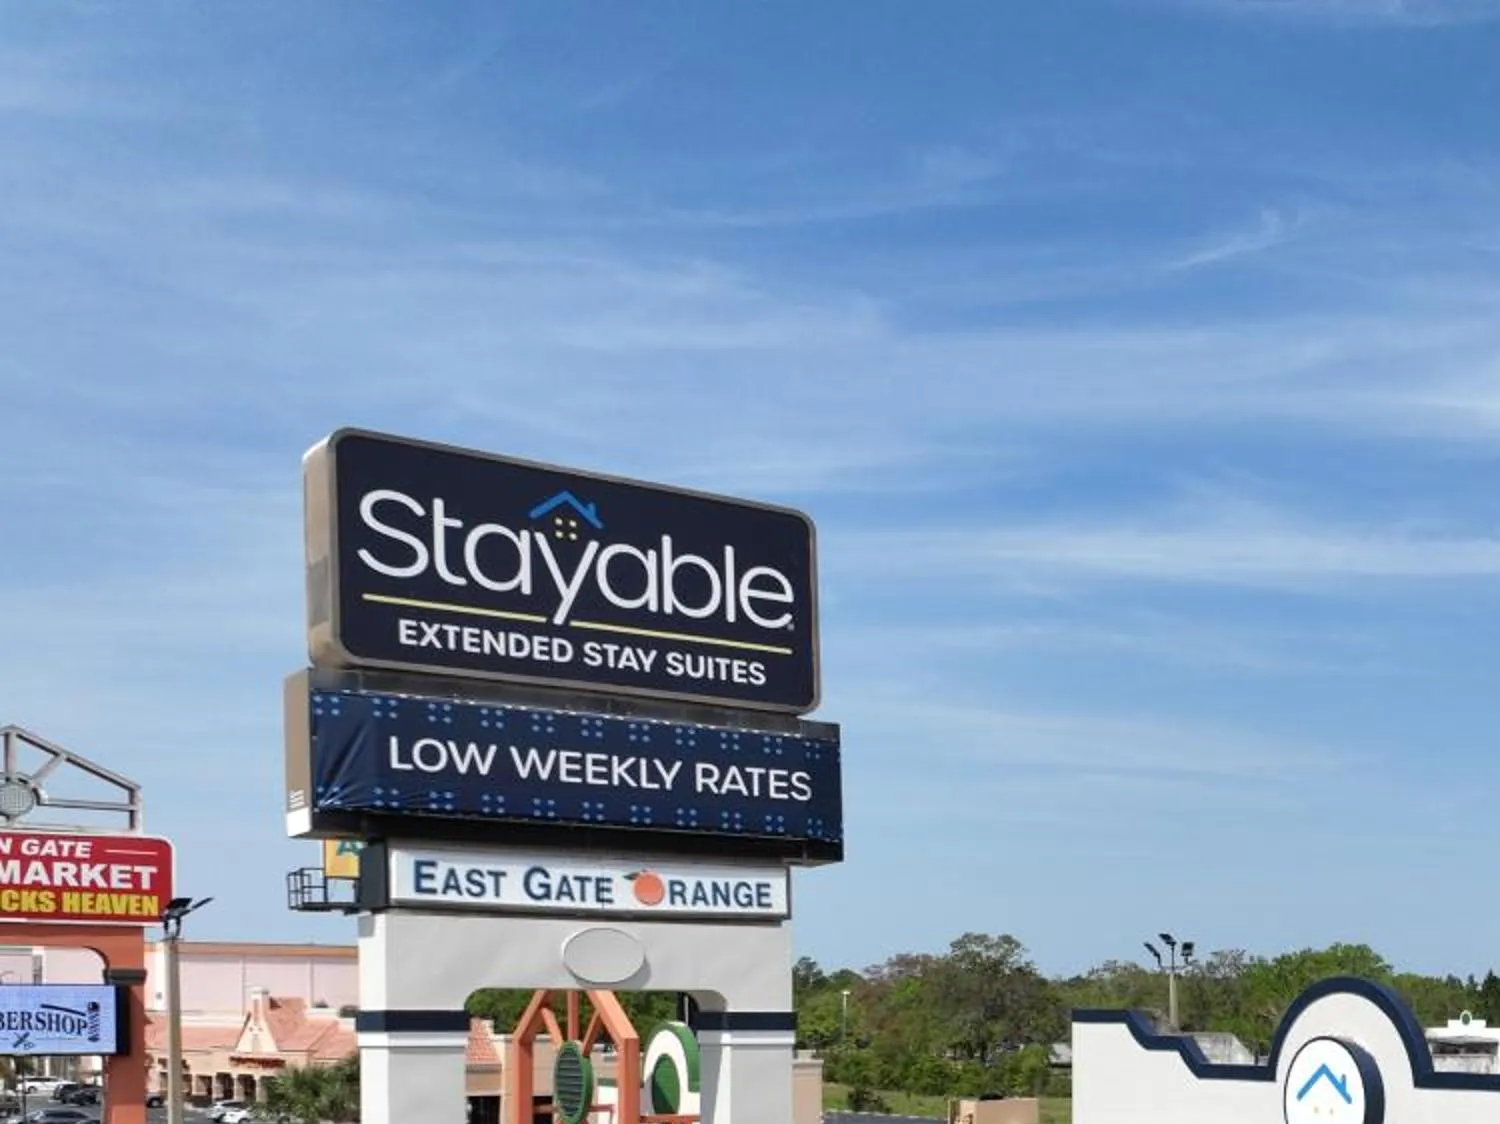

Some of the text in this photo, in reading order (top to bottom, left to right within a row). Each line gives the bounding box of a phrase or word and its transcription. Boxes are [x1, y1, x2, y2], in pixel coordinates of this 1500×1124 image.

[357, 489, 795, 630] Stayable
[398, 618, 767, 687] EXTENDED STAY SUITES
[389, 734, 813, 802] LOW WEEKLY RATES
[21, 838, 93, 859] GATE
[0, 858, 158, 890] MARKET
[412, 858, 508, 899] EAST
[522, 864, 615, 905] GATE
[61, 891, 160, 917] HEAVEN
